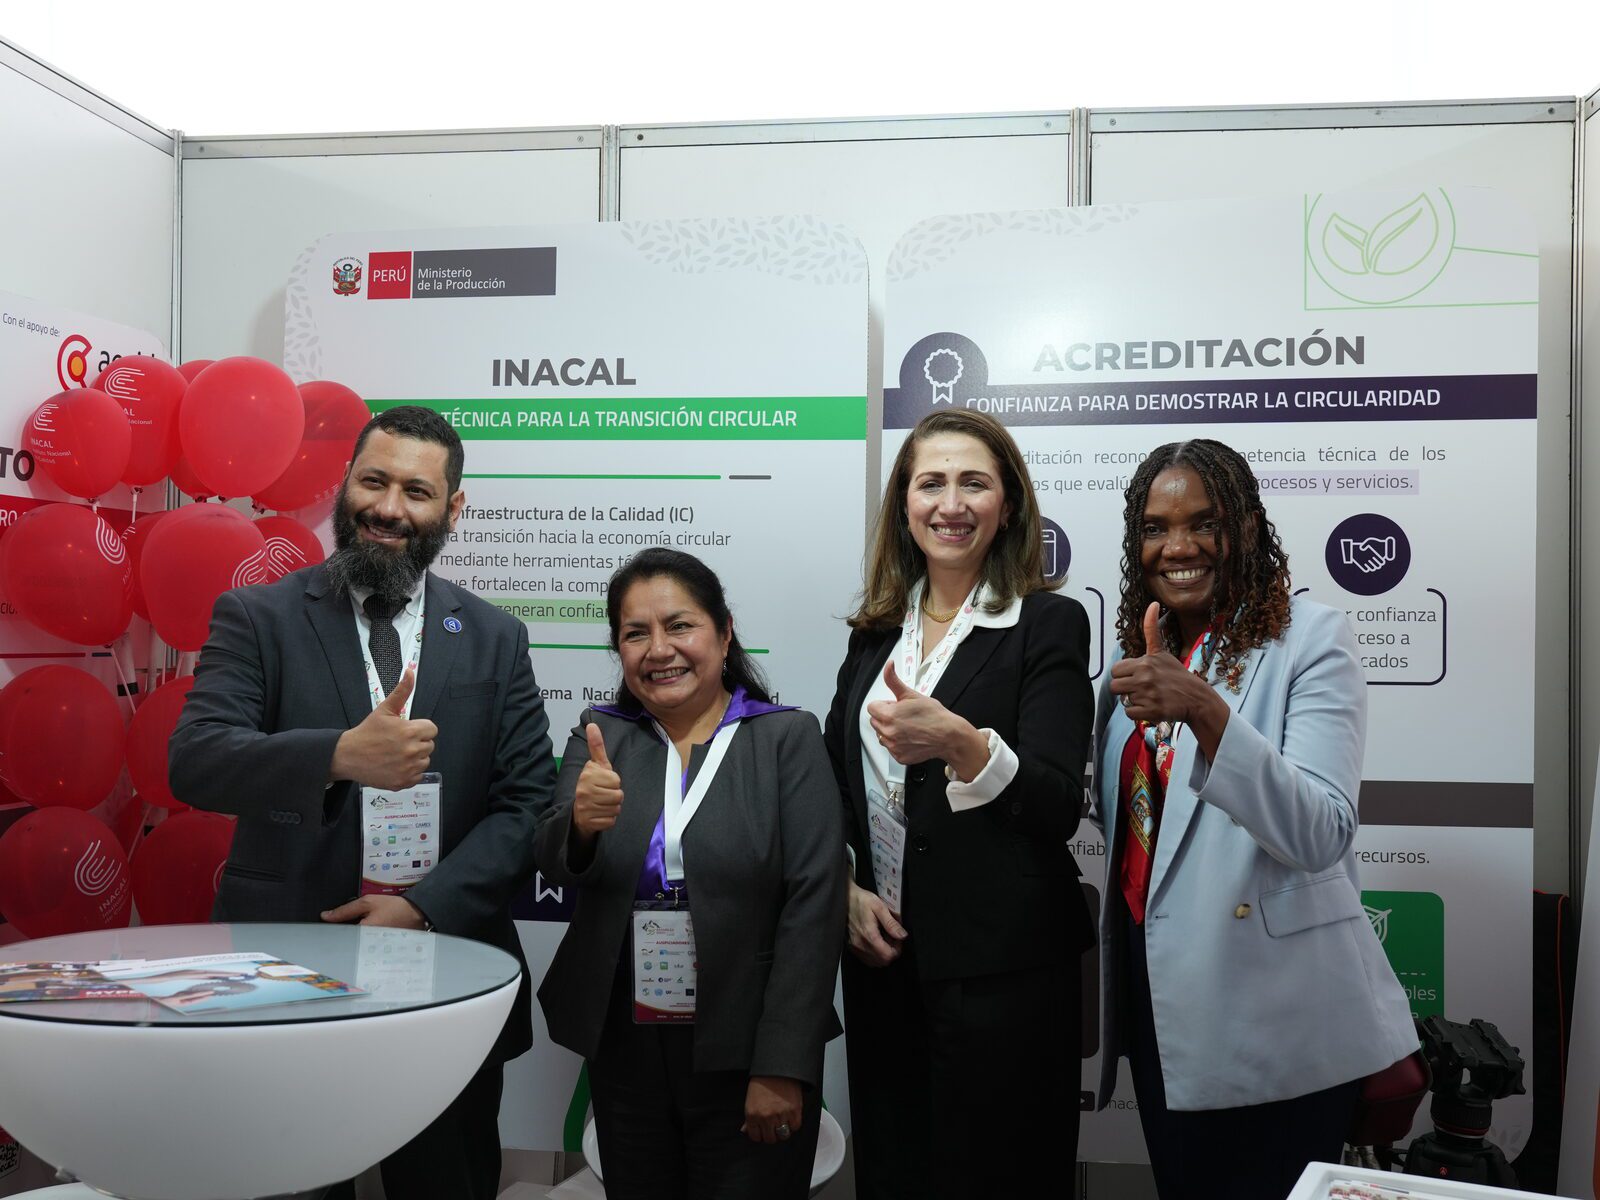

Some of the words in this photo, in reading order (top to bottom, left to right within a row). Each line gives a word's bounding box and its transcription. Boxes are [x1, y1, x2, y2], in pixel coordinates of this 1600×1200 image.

[373, 266, 406, 282] PERÚ
[418, 267, 472, 279] Ministerio
[417, 281, 430, 290] de
[434, 280, 443, 290] la
[446, 278, 506, 290] Producción
[2, 313, 17, 327] Con
[18, 316, 26, 328] el
[27, 320, 49, 336] apoyo
[49, 326, 61, 338] de:
[1032, 329, 1365, 372] ACREDITACIÓN
[492, 357, 637, 387] INACAL
[966, 396, 1073, 413] CONFIANZA
[1078, 395, 1130, 412] PARA
[1135, 392, 1258, 411] DEMOSTRAR
[1264, 392, 1289, 409] LA
[1294, 389, 1441, 408] CIRCULARIDAD
[123, 407, 136, 417] AL
[441, 407, 512, 427] TÉCNICA
[517, 411, 564, 427] PARA
[568, 411, 590, 427] LA
[595, 406, 703, 427] TRANSICIÓN
[708, 410, 798, 427] CIRCULAR
[1022, 450, 1082, 465] ditación
[1094, 453, 1148, 464] recono
[1318, 446, 1376, 462] técnica
[1389, 446, 1409, 461] de
[1422, 445, 1446, 461] los
[1032, 480, 1049, 491] os
[1054, 478, 1082, 494] que
[1087, 476, 1130, 491] evalú
[1322, 478, 1331, 493] y
[1336, 474, 1413, 489] servicios.
[568, 506, 587, 521] de
[591, 506, 604, 521] la
[609, 507, 664, 522] Calidad
[669, 506, 694, 524] (IC)
[463, 528, 534, 543] transición
[539, 529, 577, 544] hacia
[582, 529, 594, 544] la
[598, 530, 671, 545] economía
[676, 531, 731, 546] circular
[440, 552, 509, 567] mediante
[513, 553, 613, 568] herramientas
[472, 576, 546, 591] fortalecen
[551, 577, 563, 592] la
[568, 581, 608, 596] comp
[1356, 607, 1437, 622] confianza
[1356, 633, 1395, 645] ceso
[1400, 633, 1410, 645] a
[541, 689, 572, 700] ema
[1355, 851, 1430, 864] recursos.
[1402, 984, 1436, 1001] bles
